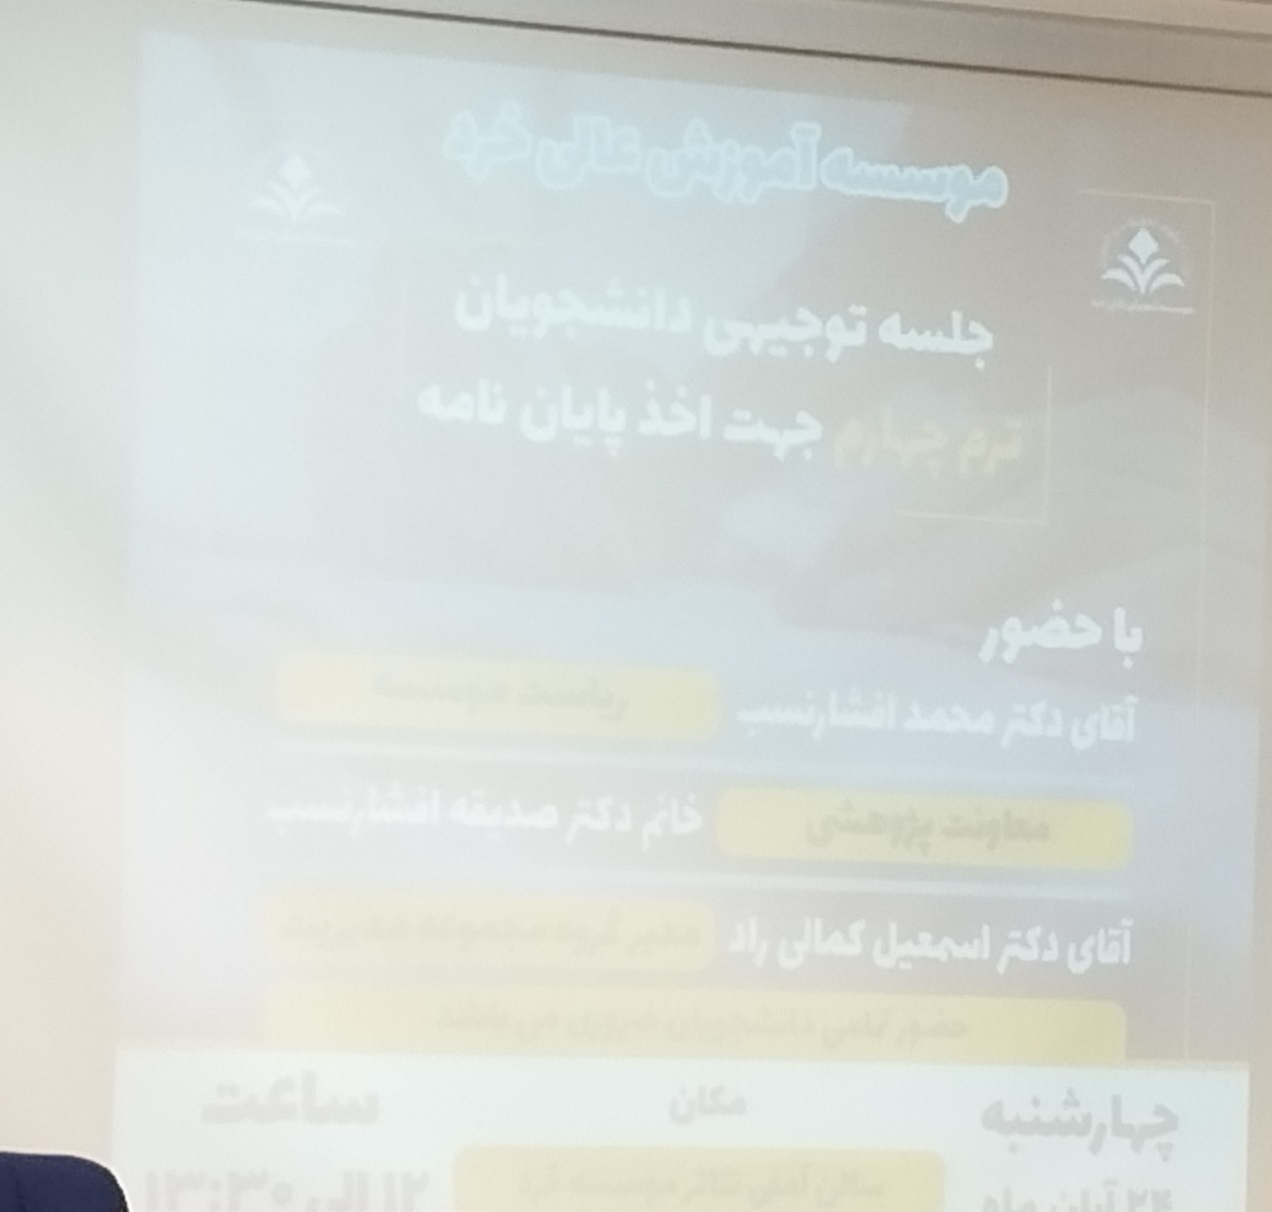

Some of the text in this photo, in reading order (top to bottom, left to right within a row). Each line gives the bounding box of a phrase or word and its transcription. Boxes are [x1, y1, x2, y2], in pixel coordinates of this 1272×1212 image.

[441, 99, 1010, 223] موسسه آموزش عالی خرد
[454, 272, 995, 371] جلسه توجیهی دانشجویان
[415, 376, 509, 426] نامه
[519, 383, 627, 460] پایان
[637, 377, 713, 440] اخذ
[723, 410, 825, 462] جهت
[957, 416, 1024, 480] ترم
[978, 596, 1144, 670] با حضور
[902, 699, 996, 735] محمد
[1000, 700, 1064, 751] دکتر
[1069, 694, 1140, 752] آقای
[449, 787, 560, 843] صدیقه
[563, 793, 633, 847] دکتر
[640, 790, 705, 853] خانم
[805, 797, 1051, 859] معاونت پژوهشی
[728, 916, 768, 969] راد
[777, 915, 868, 971] کمالی
[996, 924, 1060, 976] دکتر
[1067, 916, 1136, 975] آقای
[201, 1069, 380, 1125] ساعت
[668, 1084, 748, 1126] مکان
[979, 1085, 1180, 1165] چهارشنبه
